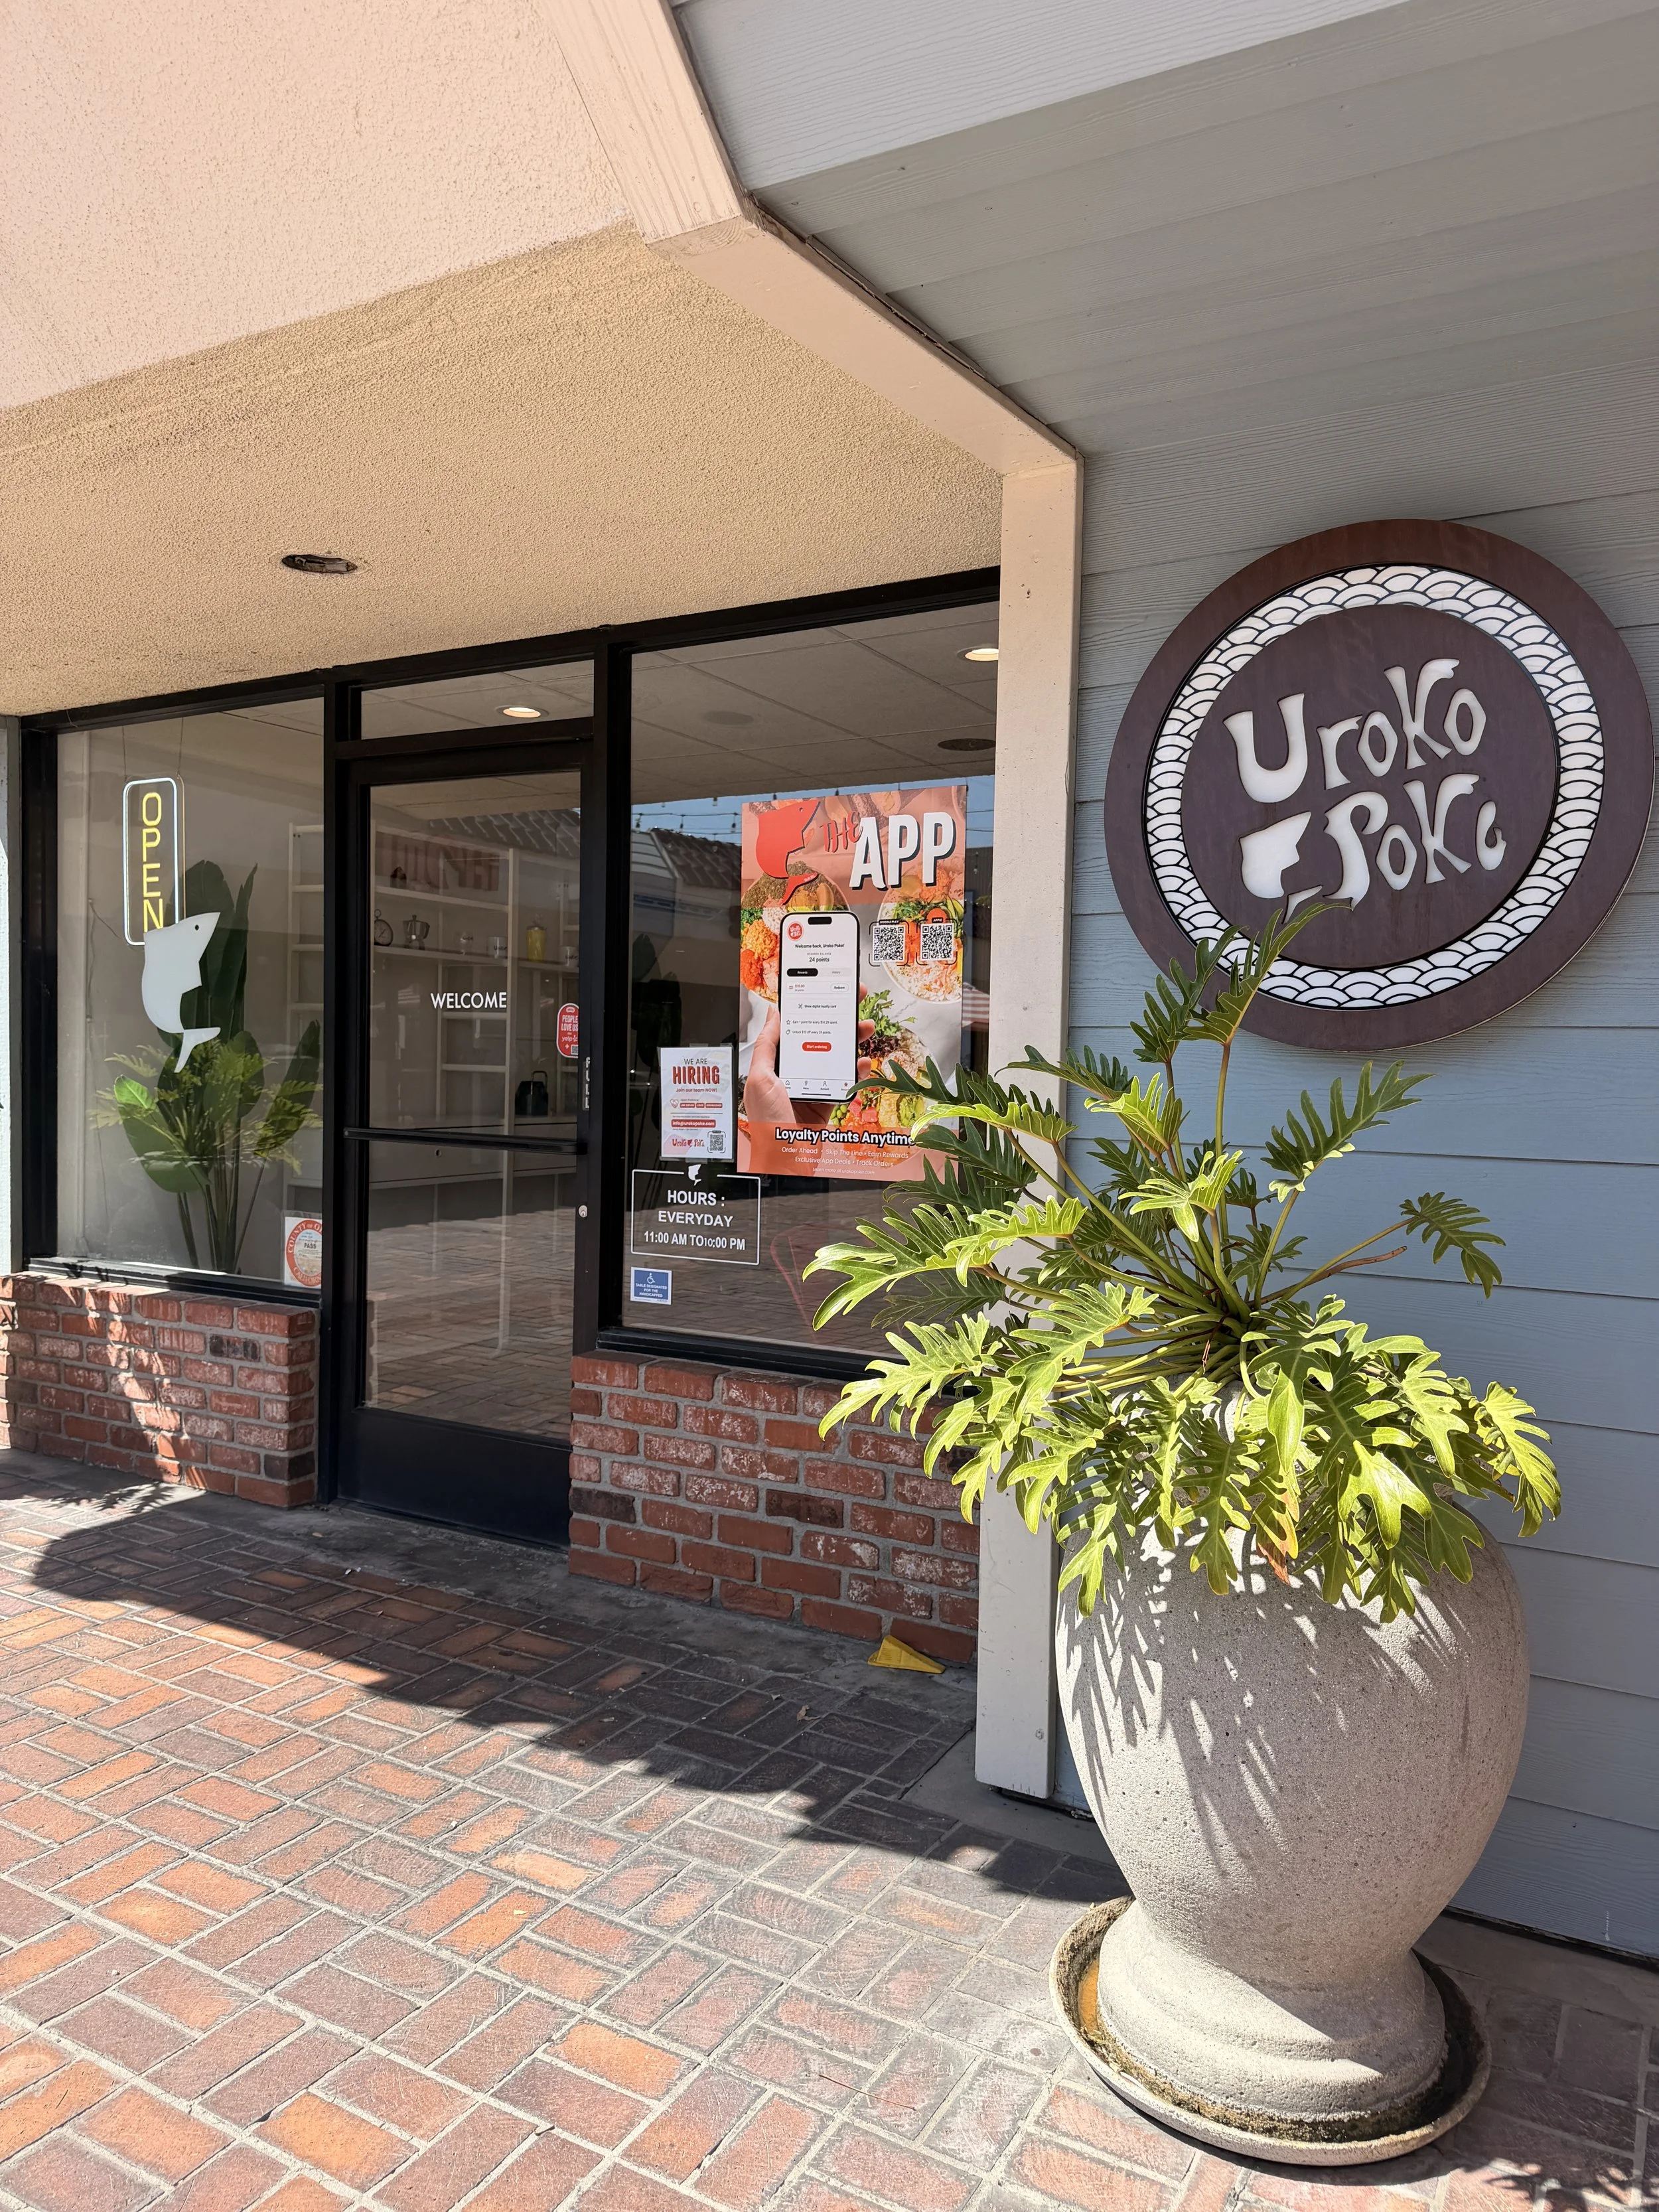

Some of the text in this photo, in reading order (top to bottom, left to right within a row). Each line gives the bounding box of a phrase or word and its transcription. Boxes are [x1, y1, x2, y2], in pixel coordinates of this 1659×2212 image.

[142, 792, 164, 930] OPEN
[849, 812, 956, 891] APP
[431, 991, 507, 1009] WELCOME
[672, 1065, 720, 1084] HIRING
[776, 1128, 820, 1145] Loyalty
[821, 1130, 859, 1143] Points
[668, 1190, 717, 1206] HOURS
[658, 1211, 733, 1227] EVERYDAY
[288, 1222, 306, 1254] COUNTY
[644, 1231, 669, 1243] 11:00
[672, 1233, 687, 1245] AM
[730, 1238, 745, 1250] PM
